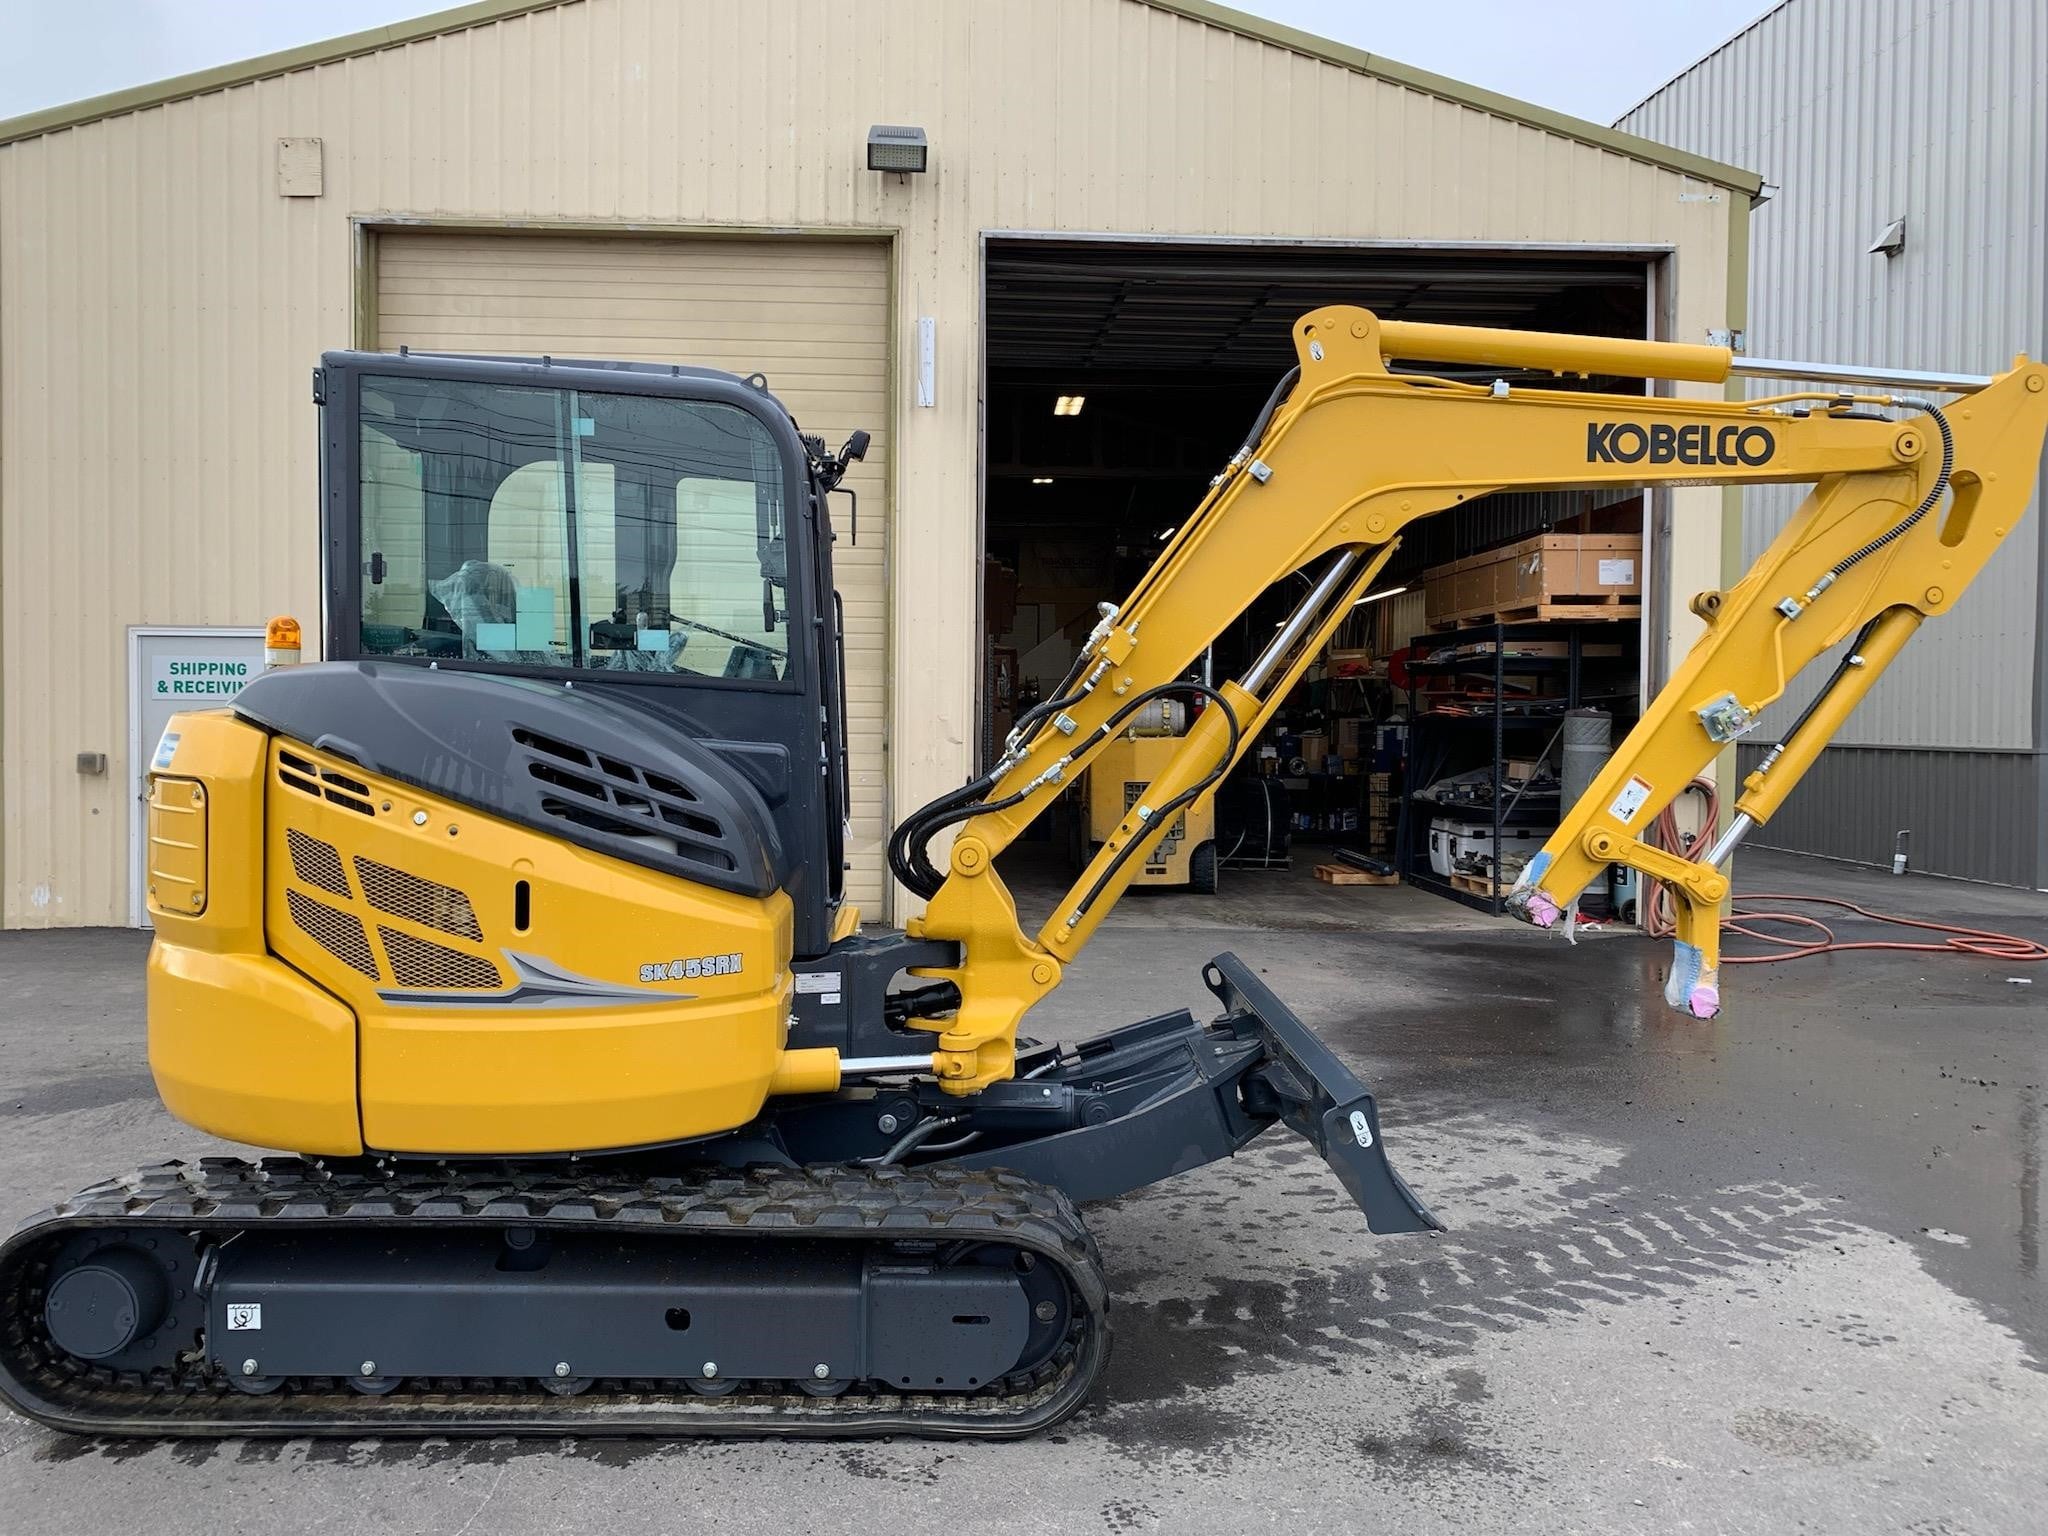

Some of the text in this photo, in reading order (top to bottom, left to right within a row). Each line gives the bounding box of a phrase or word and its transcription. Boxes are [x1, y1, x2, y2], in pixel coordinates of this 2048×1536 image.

[1587, 422, 1775, 466] KOBELCO
[169, 662, 247, 675] SHIPPING
[157, 681, 169, 693] &
[639, 953, 743, 982] SK45SRX
